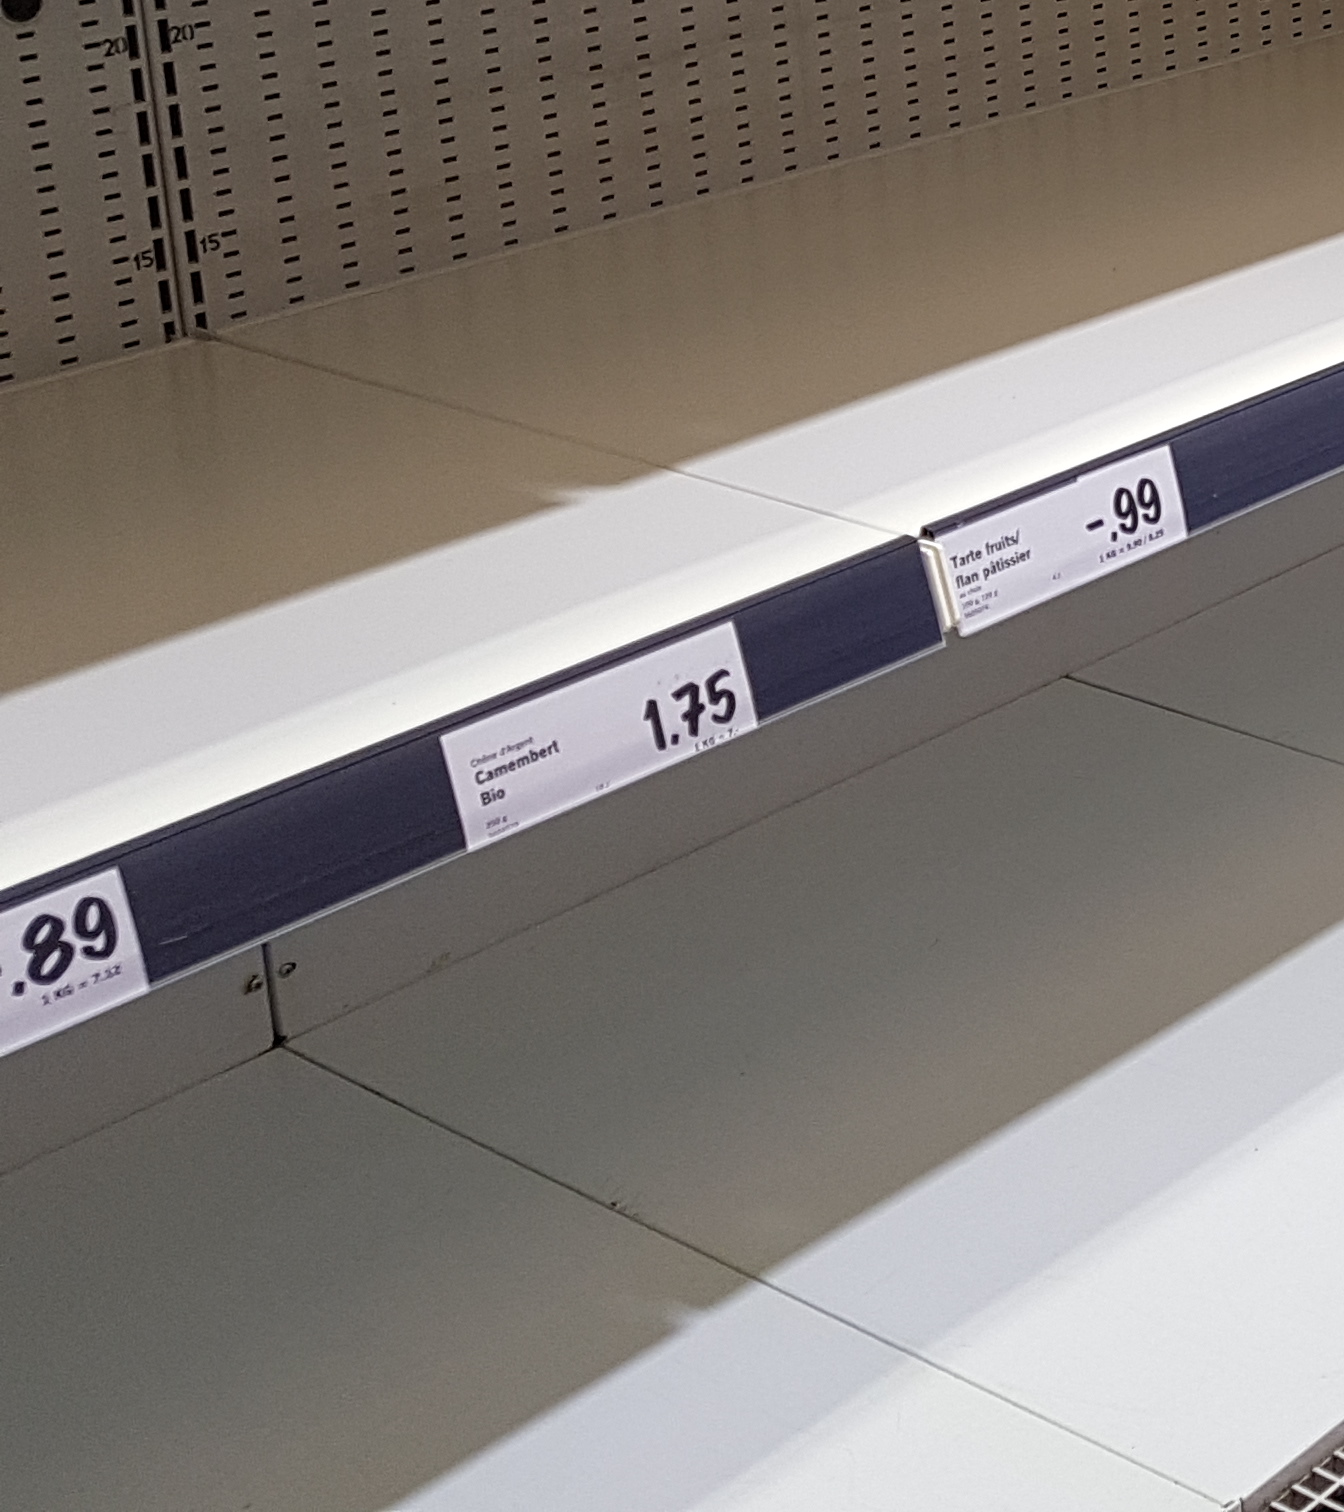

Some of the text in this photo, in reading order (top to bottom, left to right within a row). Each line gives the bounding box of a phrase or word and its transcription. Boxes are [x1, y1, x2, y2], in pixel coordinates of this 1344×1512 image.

[950, 550, 982, 570] Tarte
[955, 548, 1031, 590] flan pâtissier
[643, 669, 736, 751] 1.75
[474, 740, 560, 785] Camembert
[480, 786, 506, 807] Bio
[0, 896, 118, 996] .89
